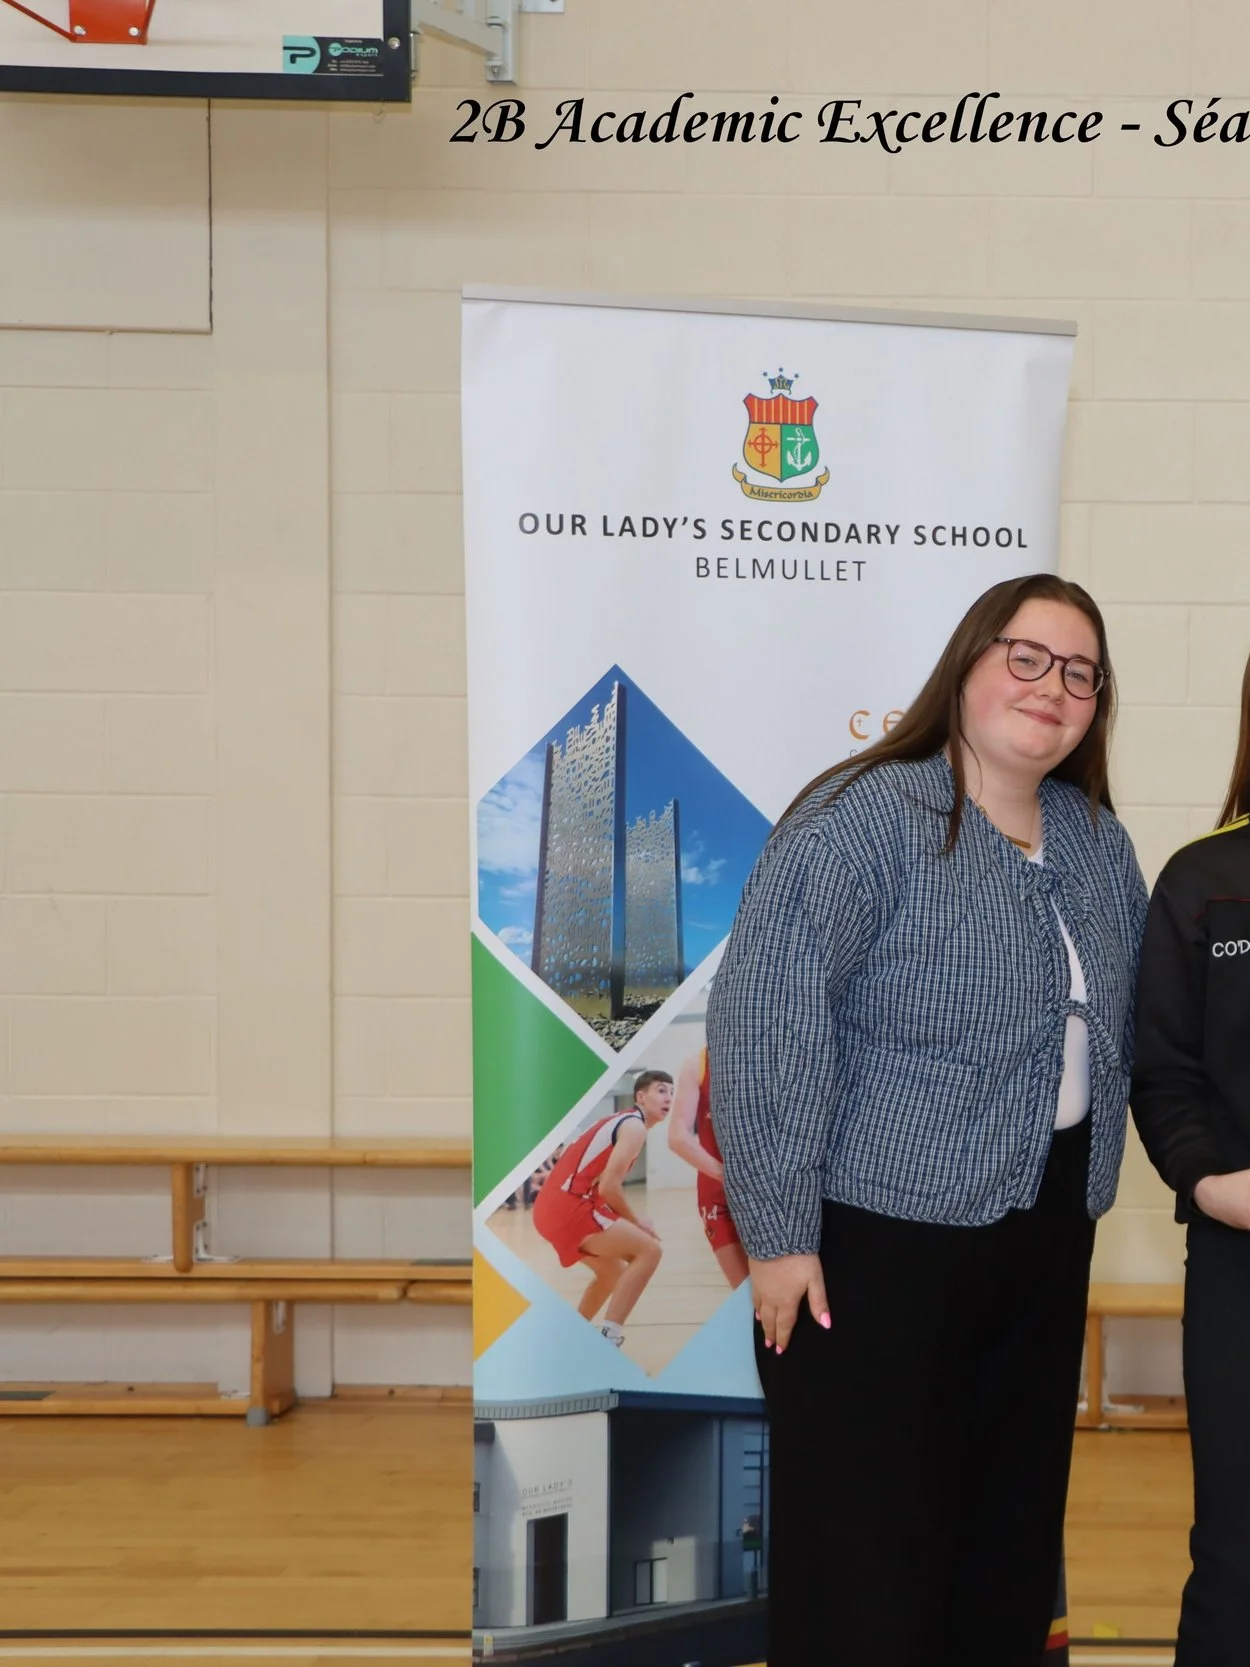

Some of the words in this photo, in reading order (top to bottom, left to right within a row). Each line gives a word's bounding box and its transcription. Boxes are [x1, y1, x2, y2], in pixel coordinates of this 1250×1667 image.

[749, 486, 814, 500] Misericordia
[518, 511, 587, 536] OUR
[602, 514, 707, 540] LADY’S
[720, 518, 900, 545] SECONDARY
[913, 524, 1029, 549] SCHOOL
[696, 556, 867, 582] BELMULLET
